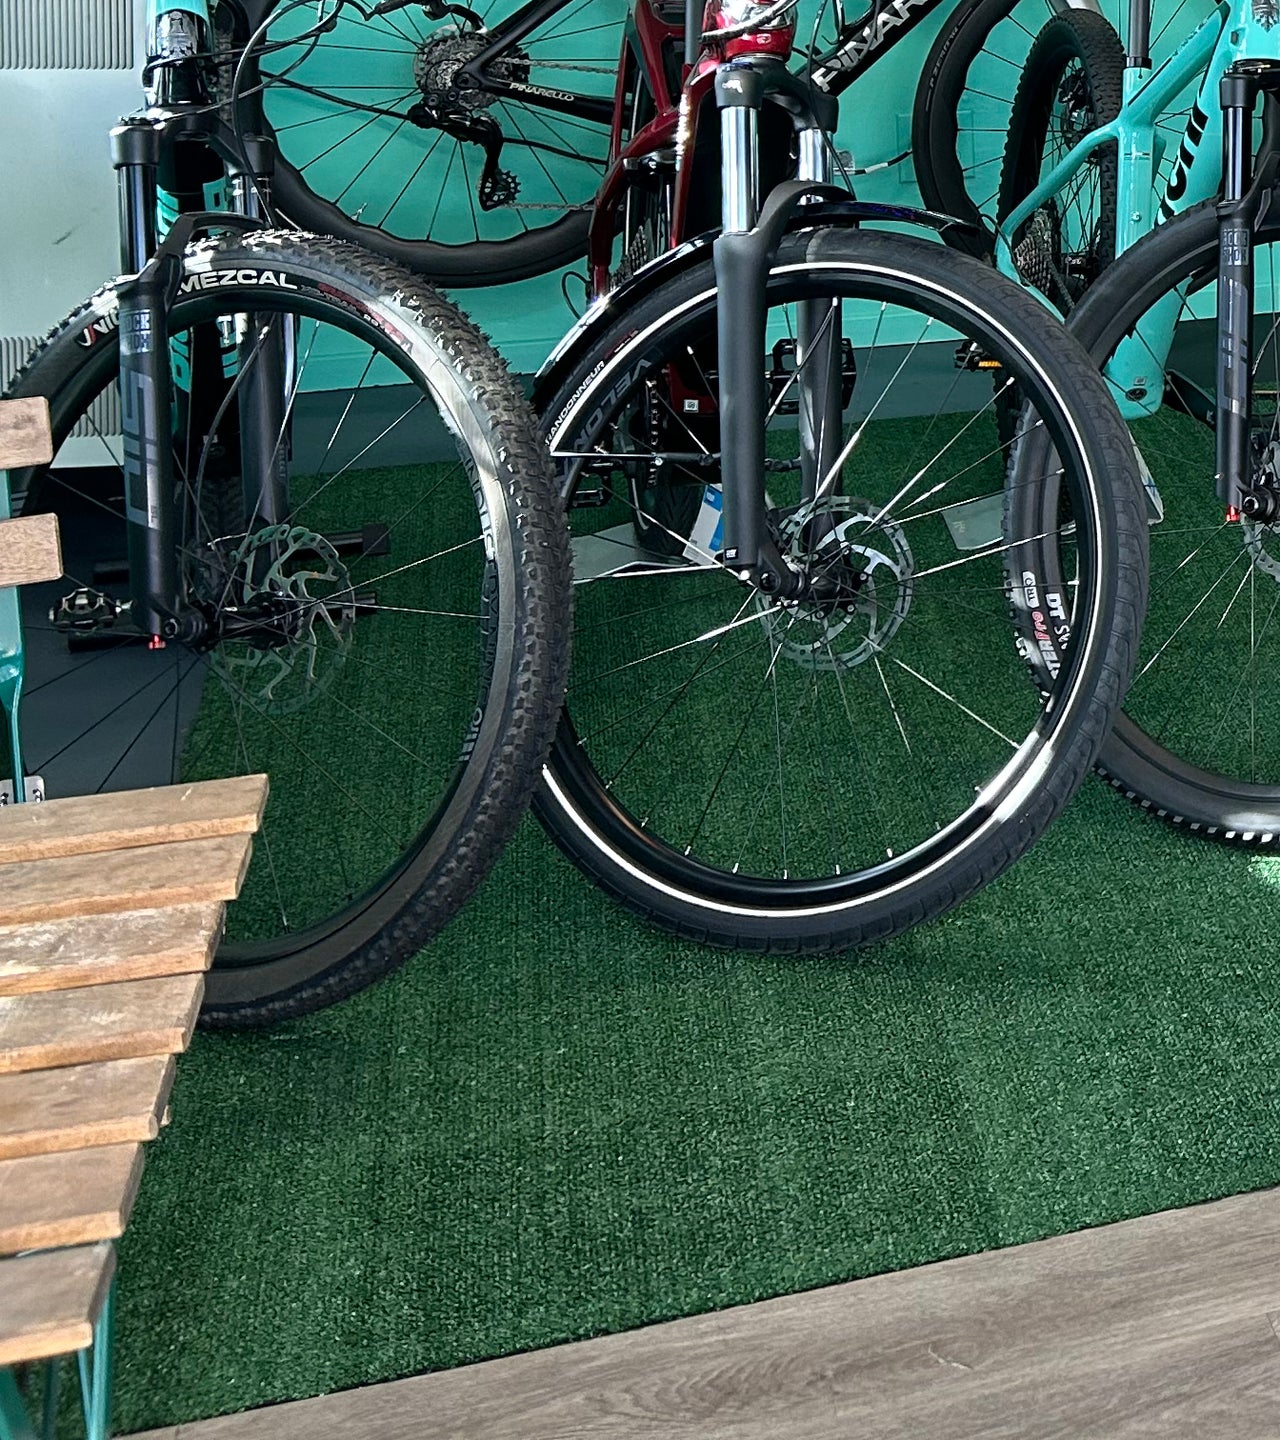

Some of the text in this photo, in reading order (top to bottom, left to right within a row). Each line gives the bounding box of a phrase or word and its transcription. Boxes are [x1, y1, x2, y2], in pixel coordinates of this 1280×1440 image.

[509, 82, 575, 102] PINARELLO
[177, 269, 299, 295] MEZCAL
[1046, 592, 1062, 616] DT
